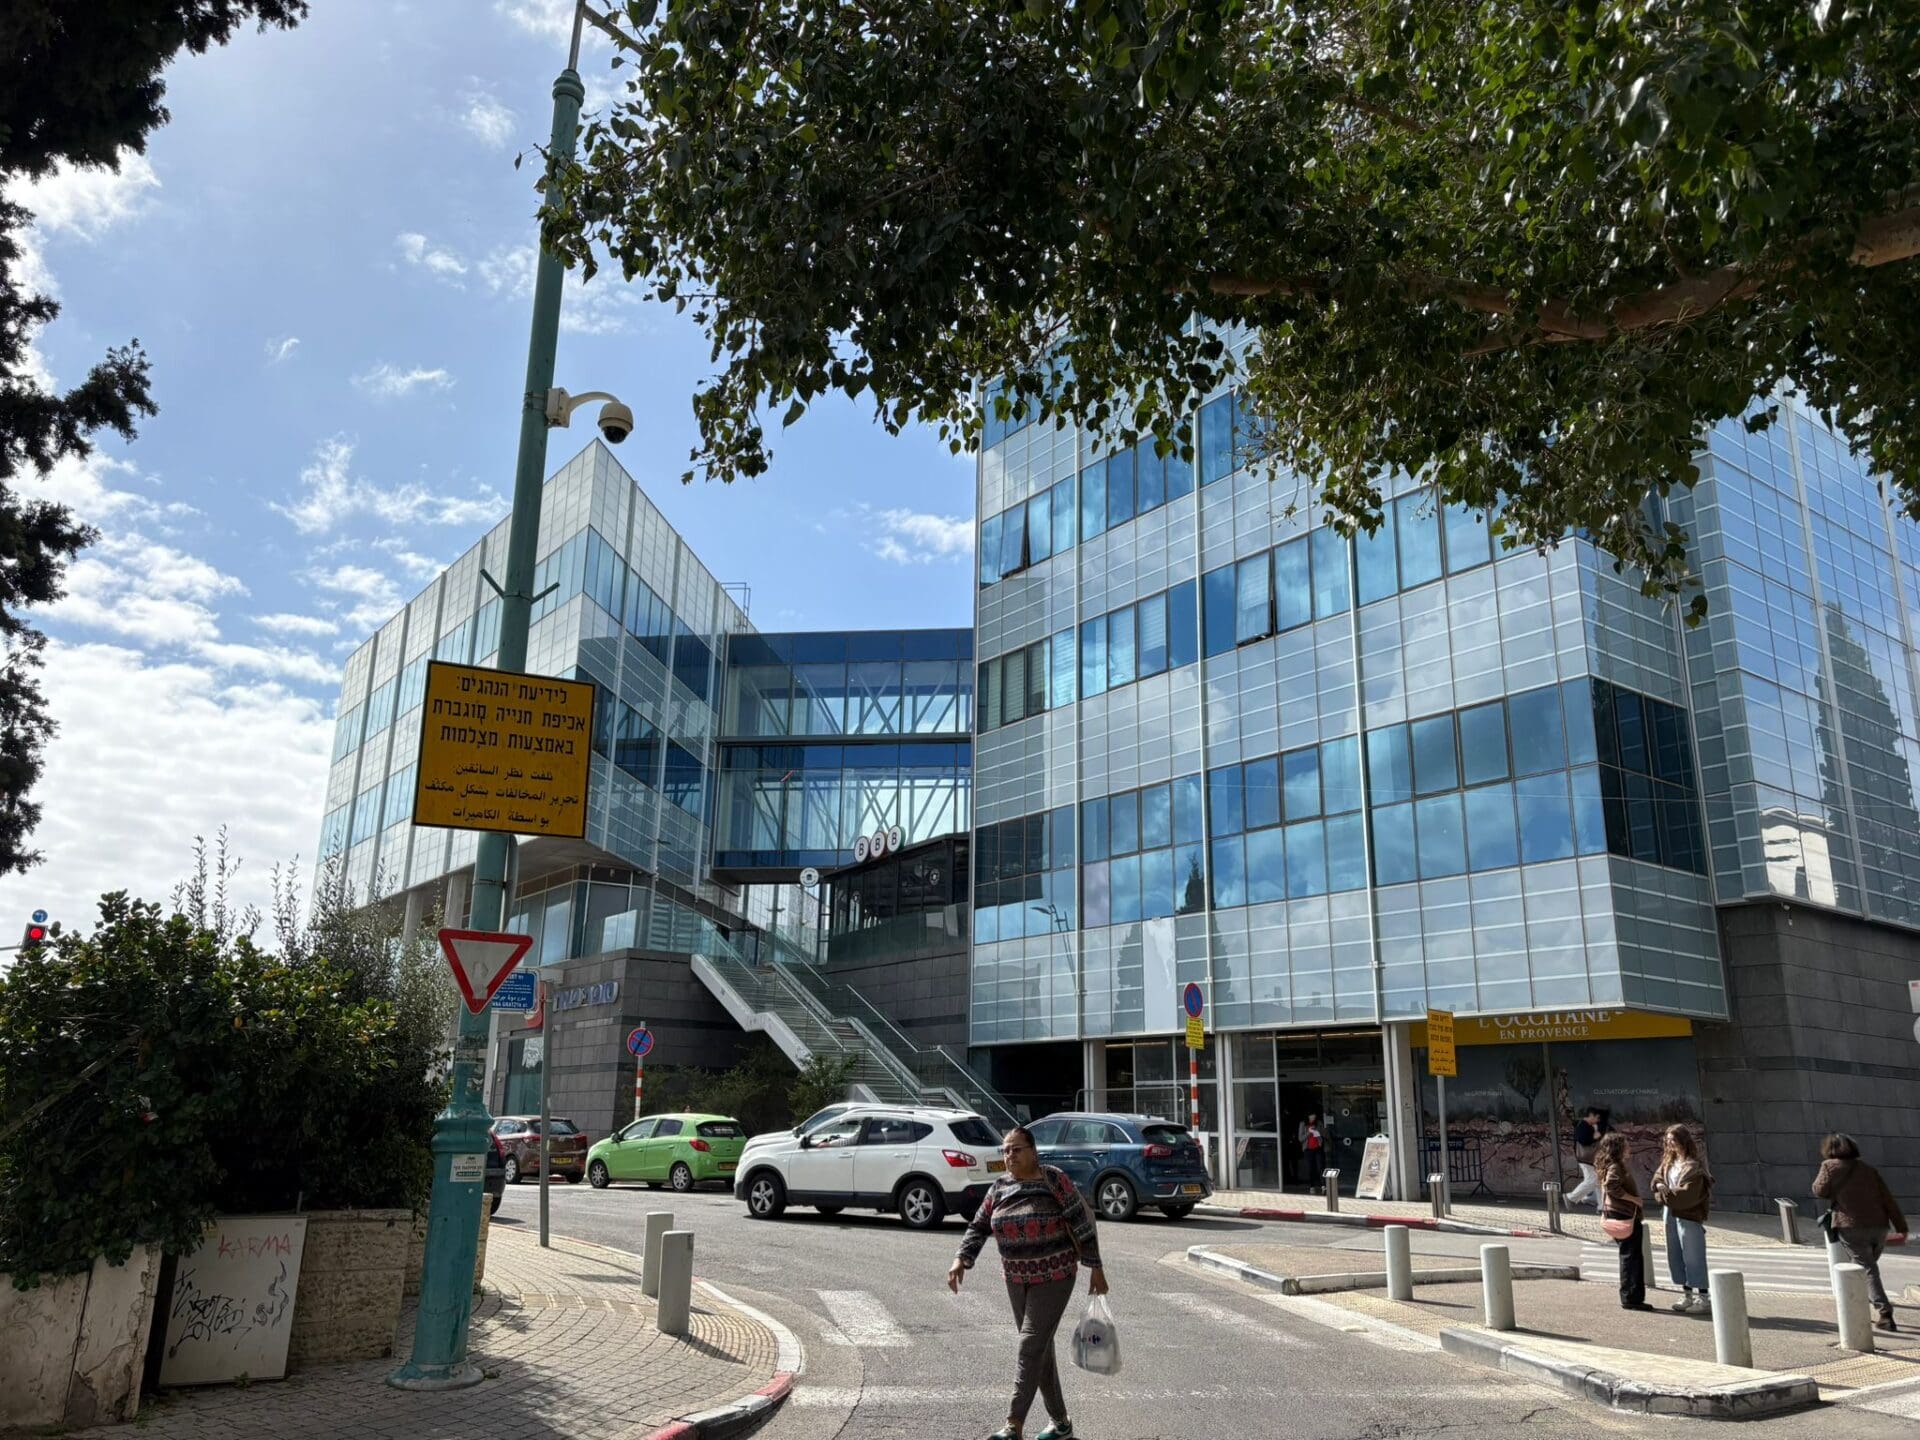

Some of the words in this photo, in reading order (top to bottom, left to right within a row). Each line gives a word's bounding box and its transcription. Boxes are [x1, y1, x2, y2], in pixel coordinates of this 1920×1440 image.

[456, 674, 509, 697] הנהגים:
[519, 684, 567, 704] לידיעת
[433, 698, 486, 722] מוגברת
[496, 706, 532, 725] חנייה
[542, 711, 585, 731] אכיפת
[440, 725, 498, 747] מצלמות
[507, 733, 574, 755] באמצעות
[504, 766, 523, 780] نظر
[460, 783, 488, 798] بشكل
[452, 806, 500, 821] الكاميرات
[1500, 1030, 1515, 1039] EN
[1520, 1026, 1590, 1038] PROVENCE
